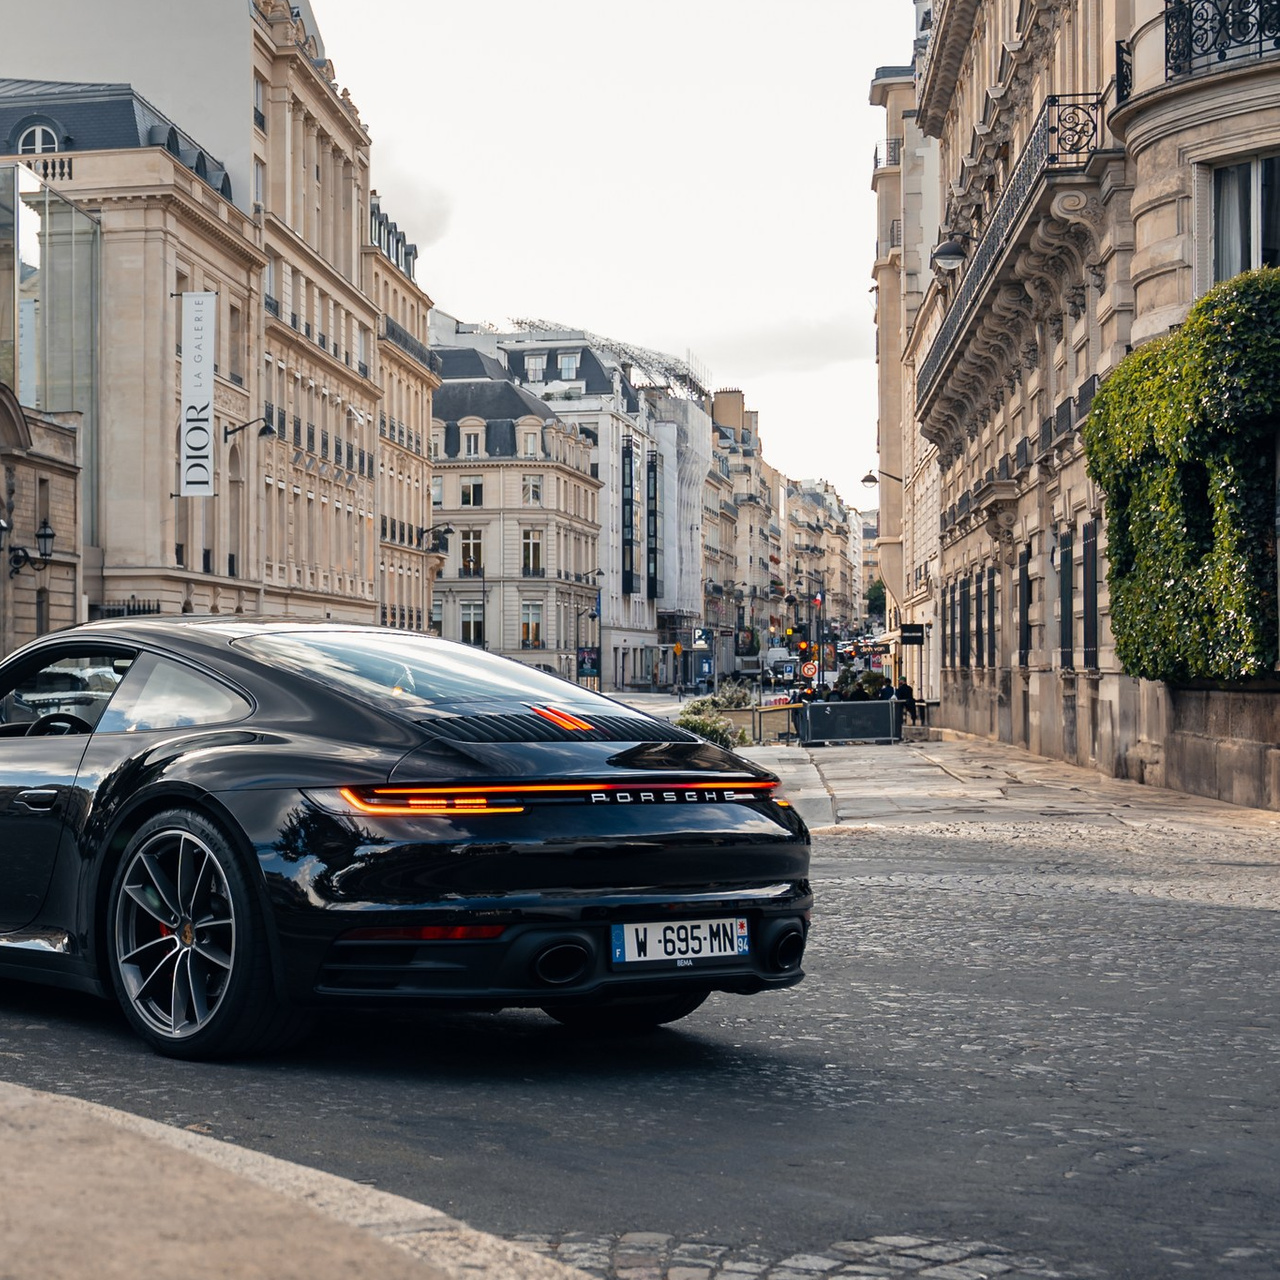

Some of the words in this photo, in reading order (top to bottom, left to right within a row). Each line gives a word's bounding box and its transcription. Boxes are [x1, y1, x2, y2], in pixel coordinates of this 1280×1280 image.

[193, 299, 204, 363] GALERIE
[193, 371, 203, 388] LA
[185, 401, 210, 488] DIOR
[694, 629, 703, 639] P
[591, 791, 735, 803] PORSCHE
[737, 937, 749, 952] 94
[616, 949, 621, 958] F
